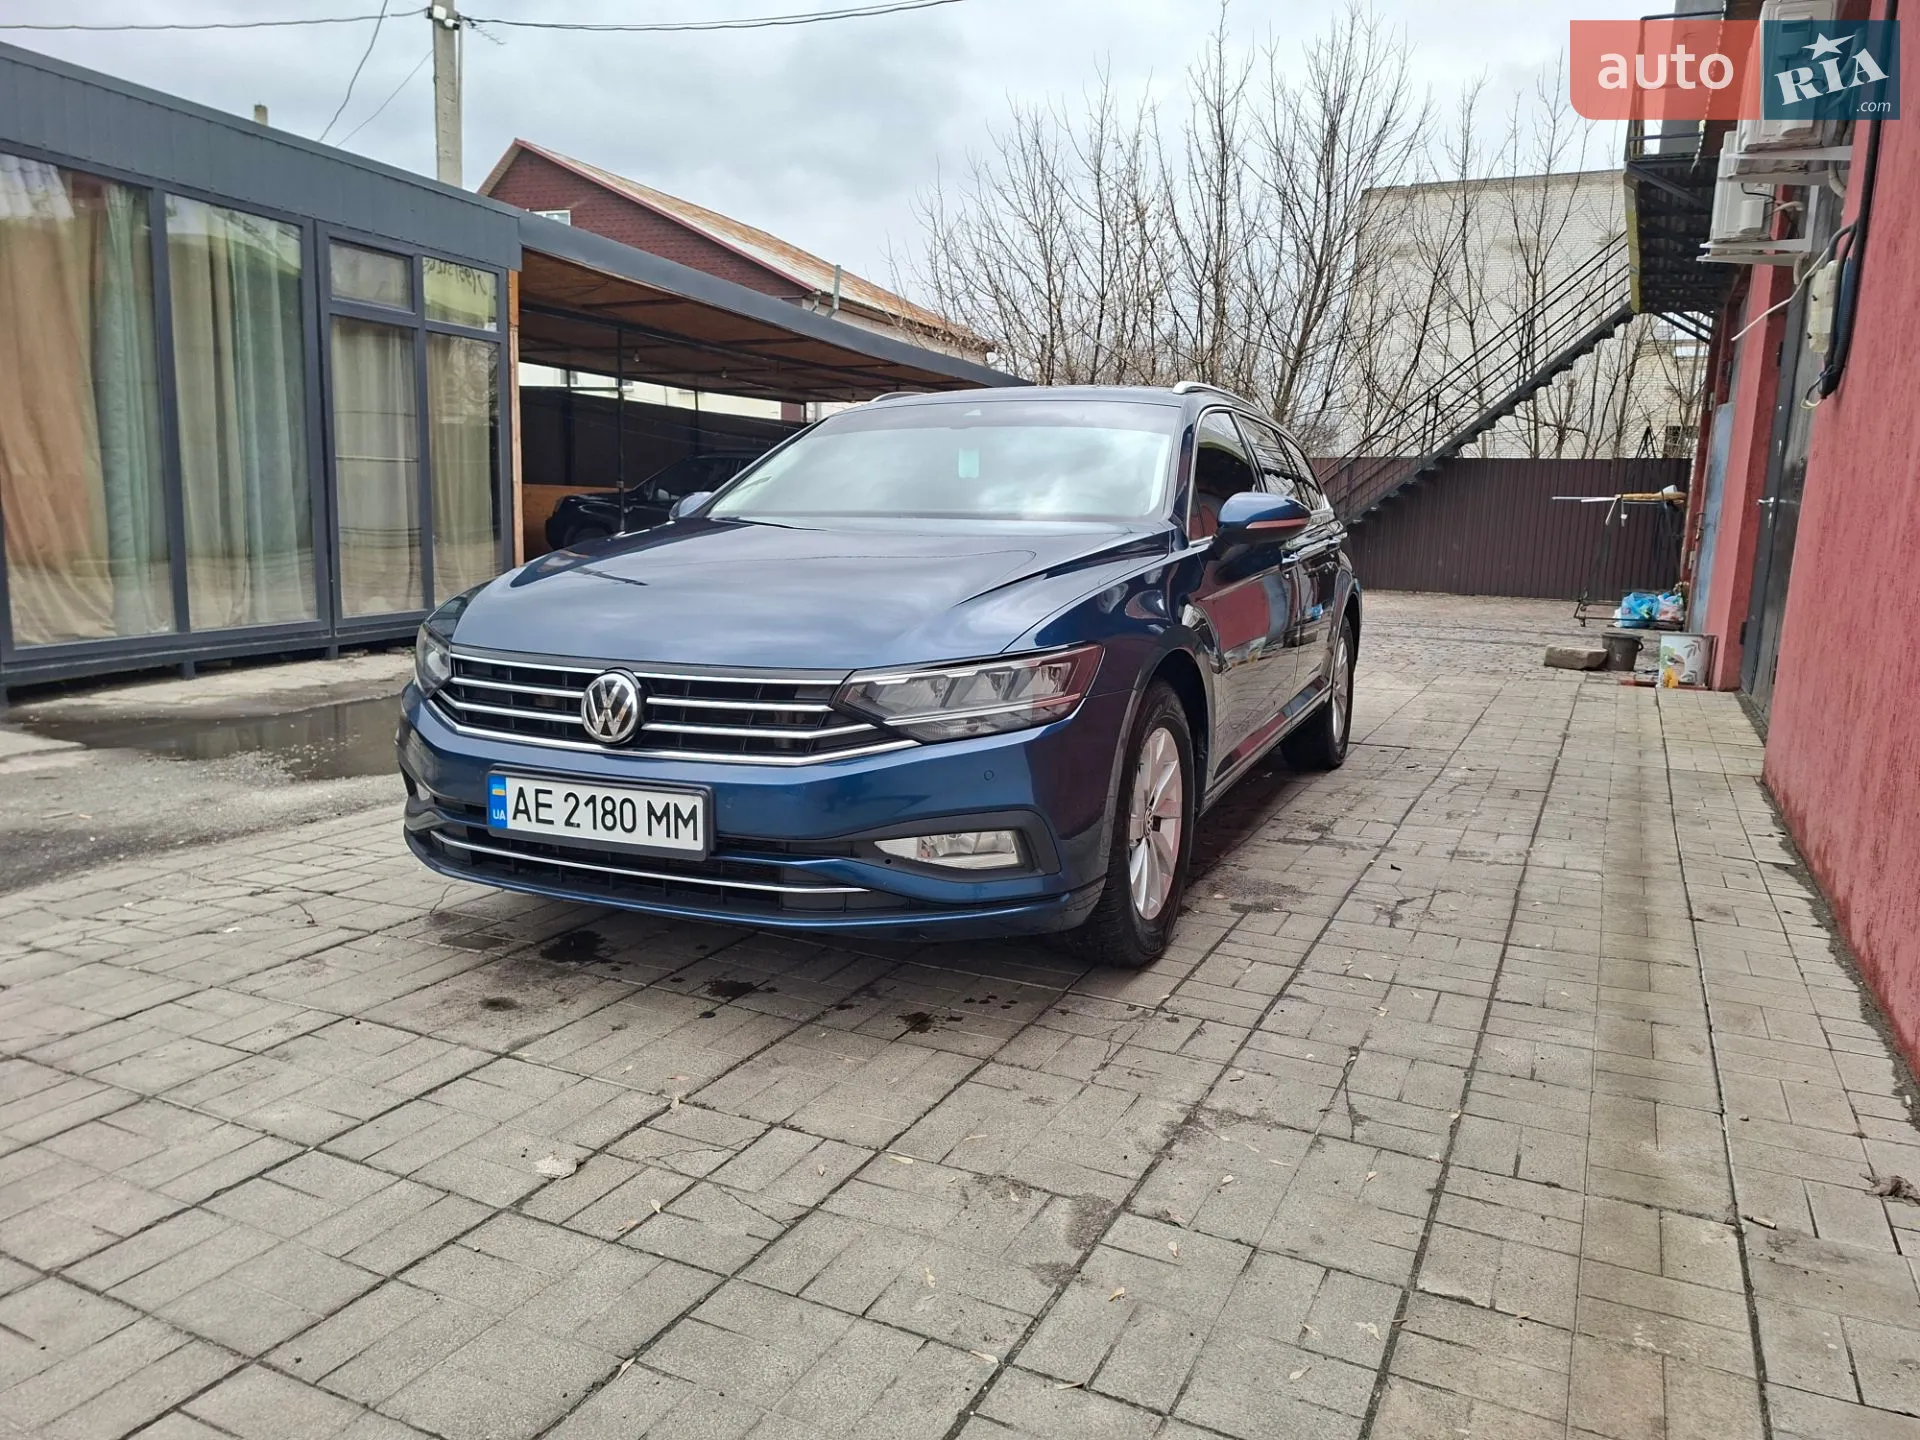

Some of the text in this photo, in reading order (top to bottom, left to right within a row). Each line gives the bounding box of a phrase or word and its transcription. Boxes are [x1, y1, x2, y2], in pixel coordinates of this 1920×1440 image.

[492, 808, 506, 821] UA
[512, 786, 698, 841] AE 2180 MM
